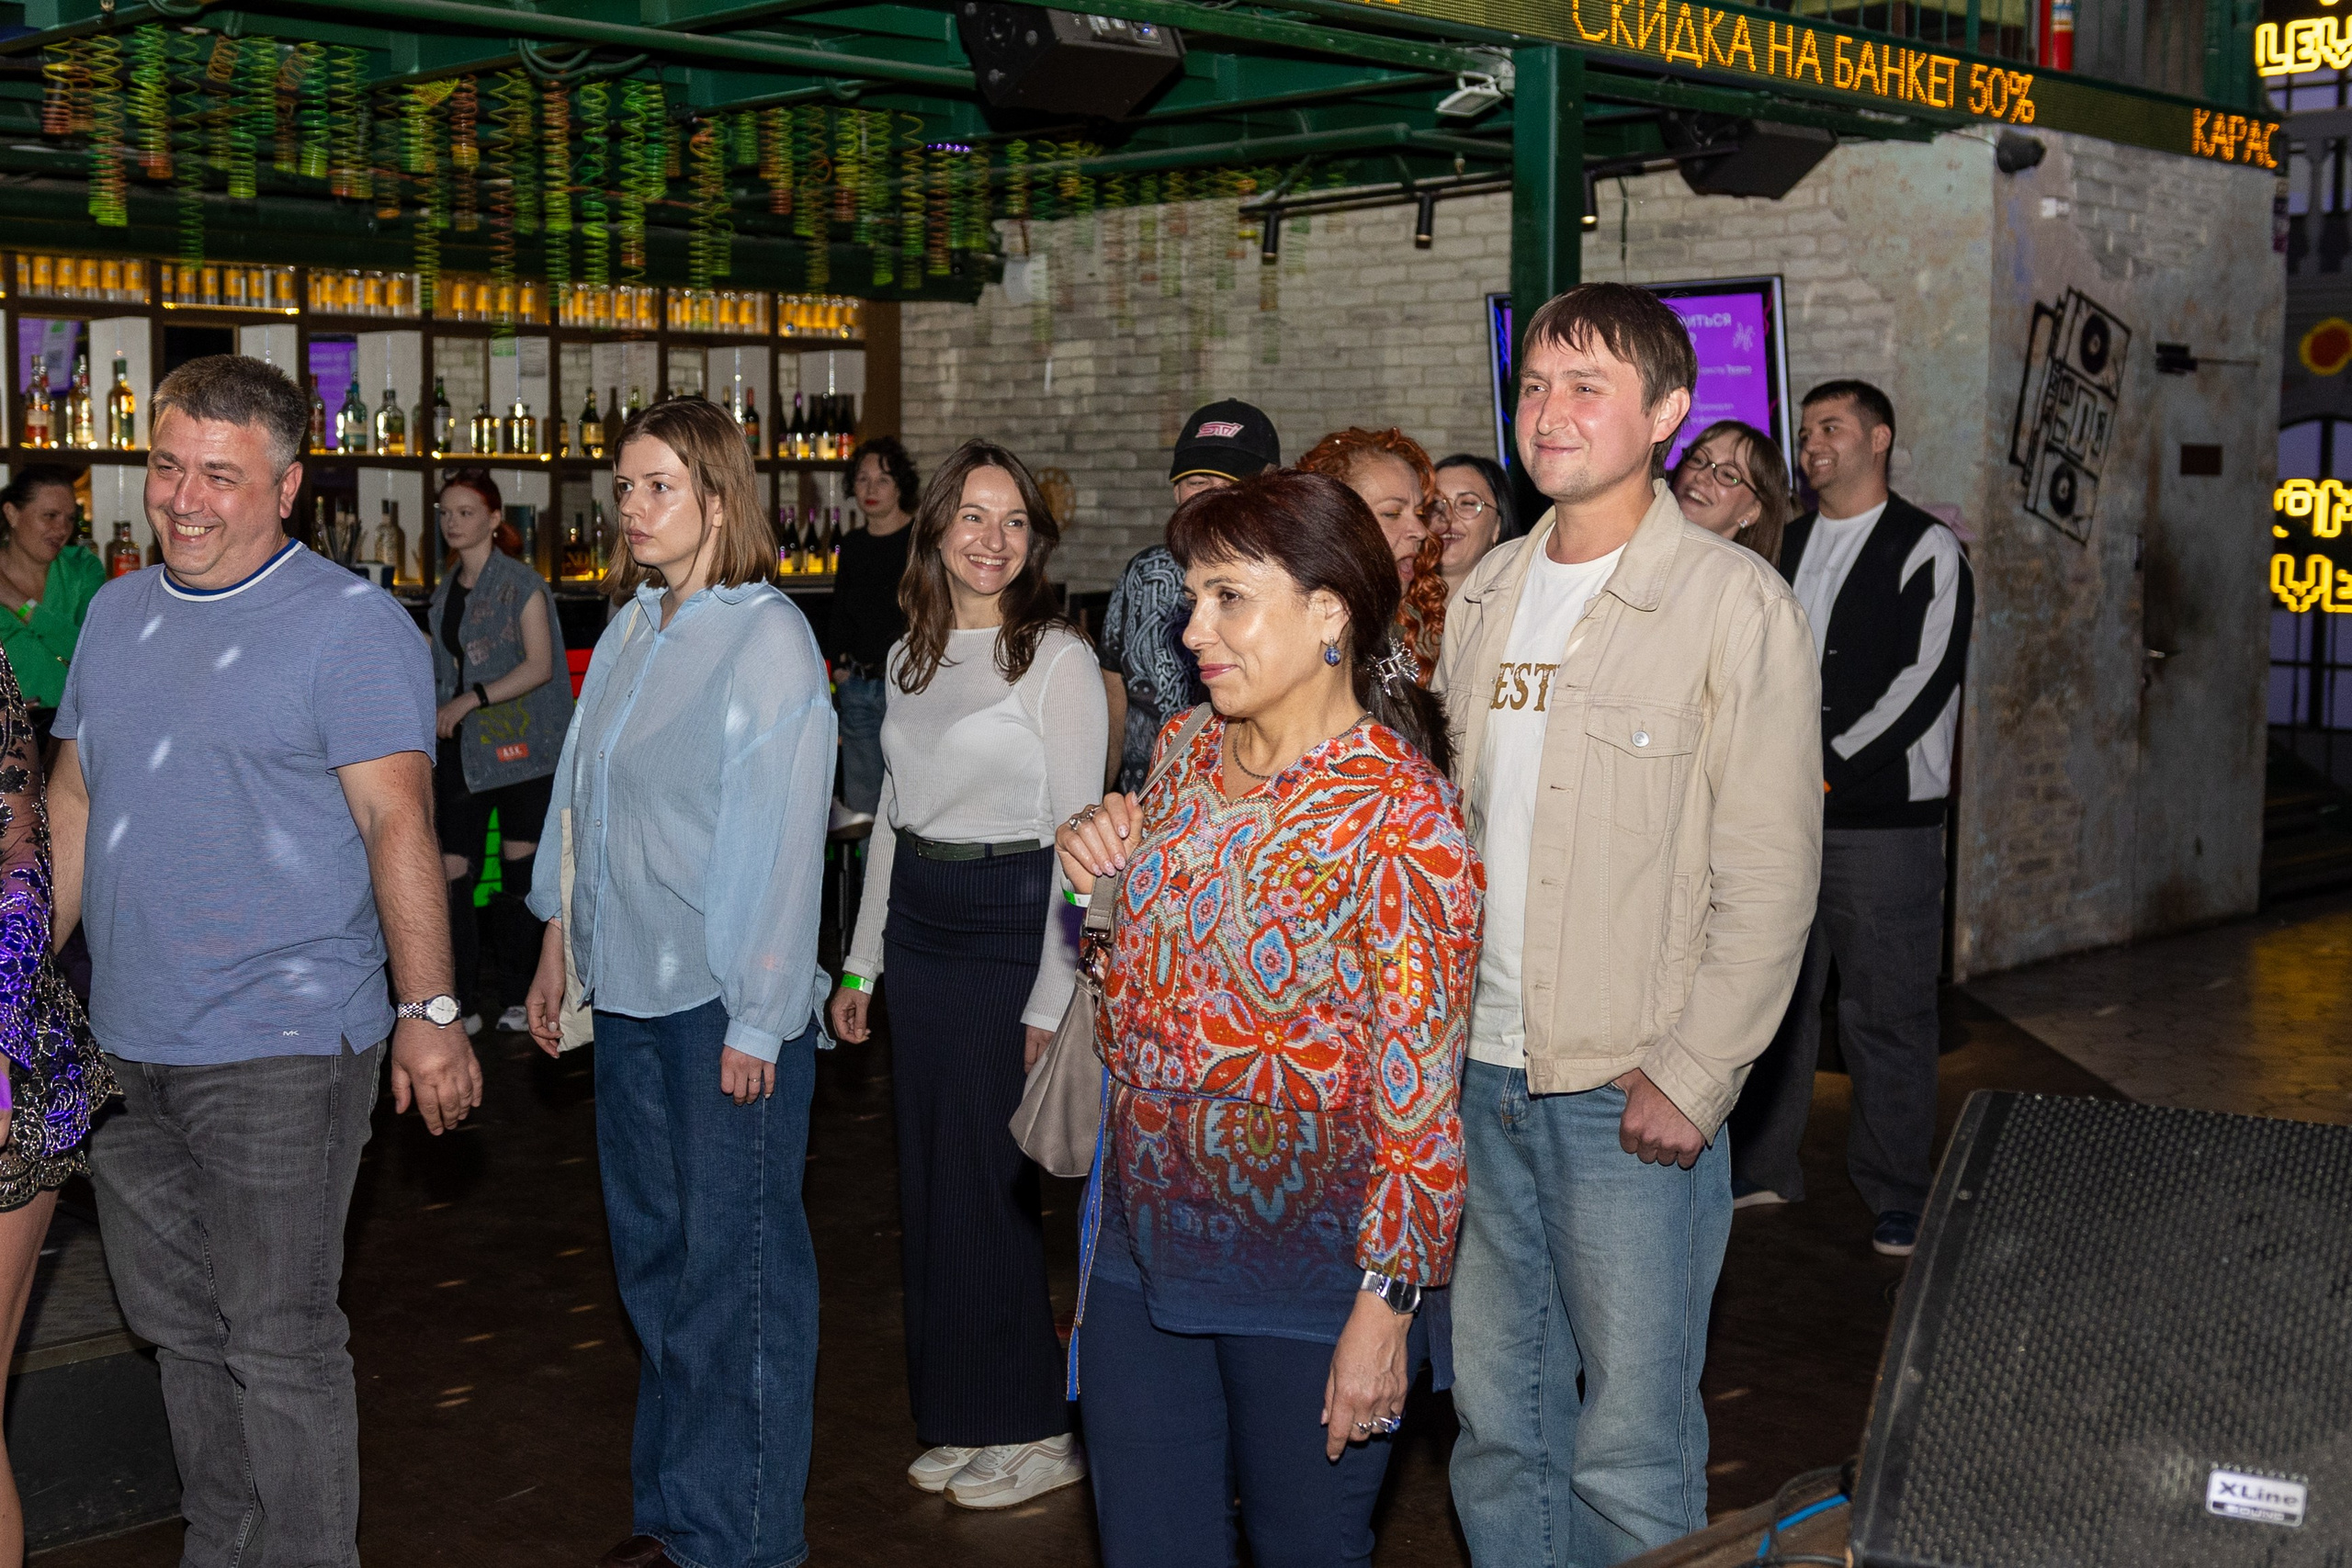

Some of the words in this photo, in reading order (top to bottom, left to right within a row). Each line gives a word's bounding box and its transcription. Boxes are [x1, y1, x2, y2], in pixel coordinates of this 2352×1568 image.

[1572, 0, 1756, 69] СКИДКА
[1768, 21, 1823, 84] НА
[1834, 34, 1960, 108] БАНКЕТ
[1967, 62, 2034, 123] 50%
[1490, 662, 1561, 712] EST
[2219, 1481, 2298, 1506] XLine
